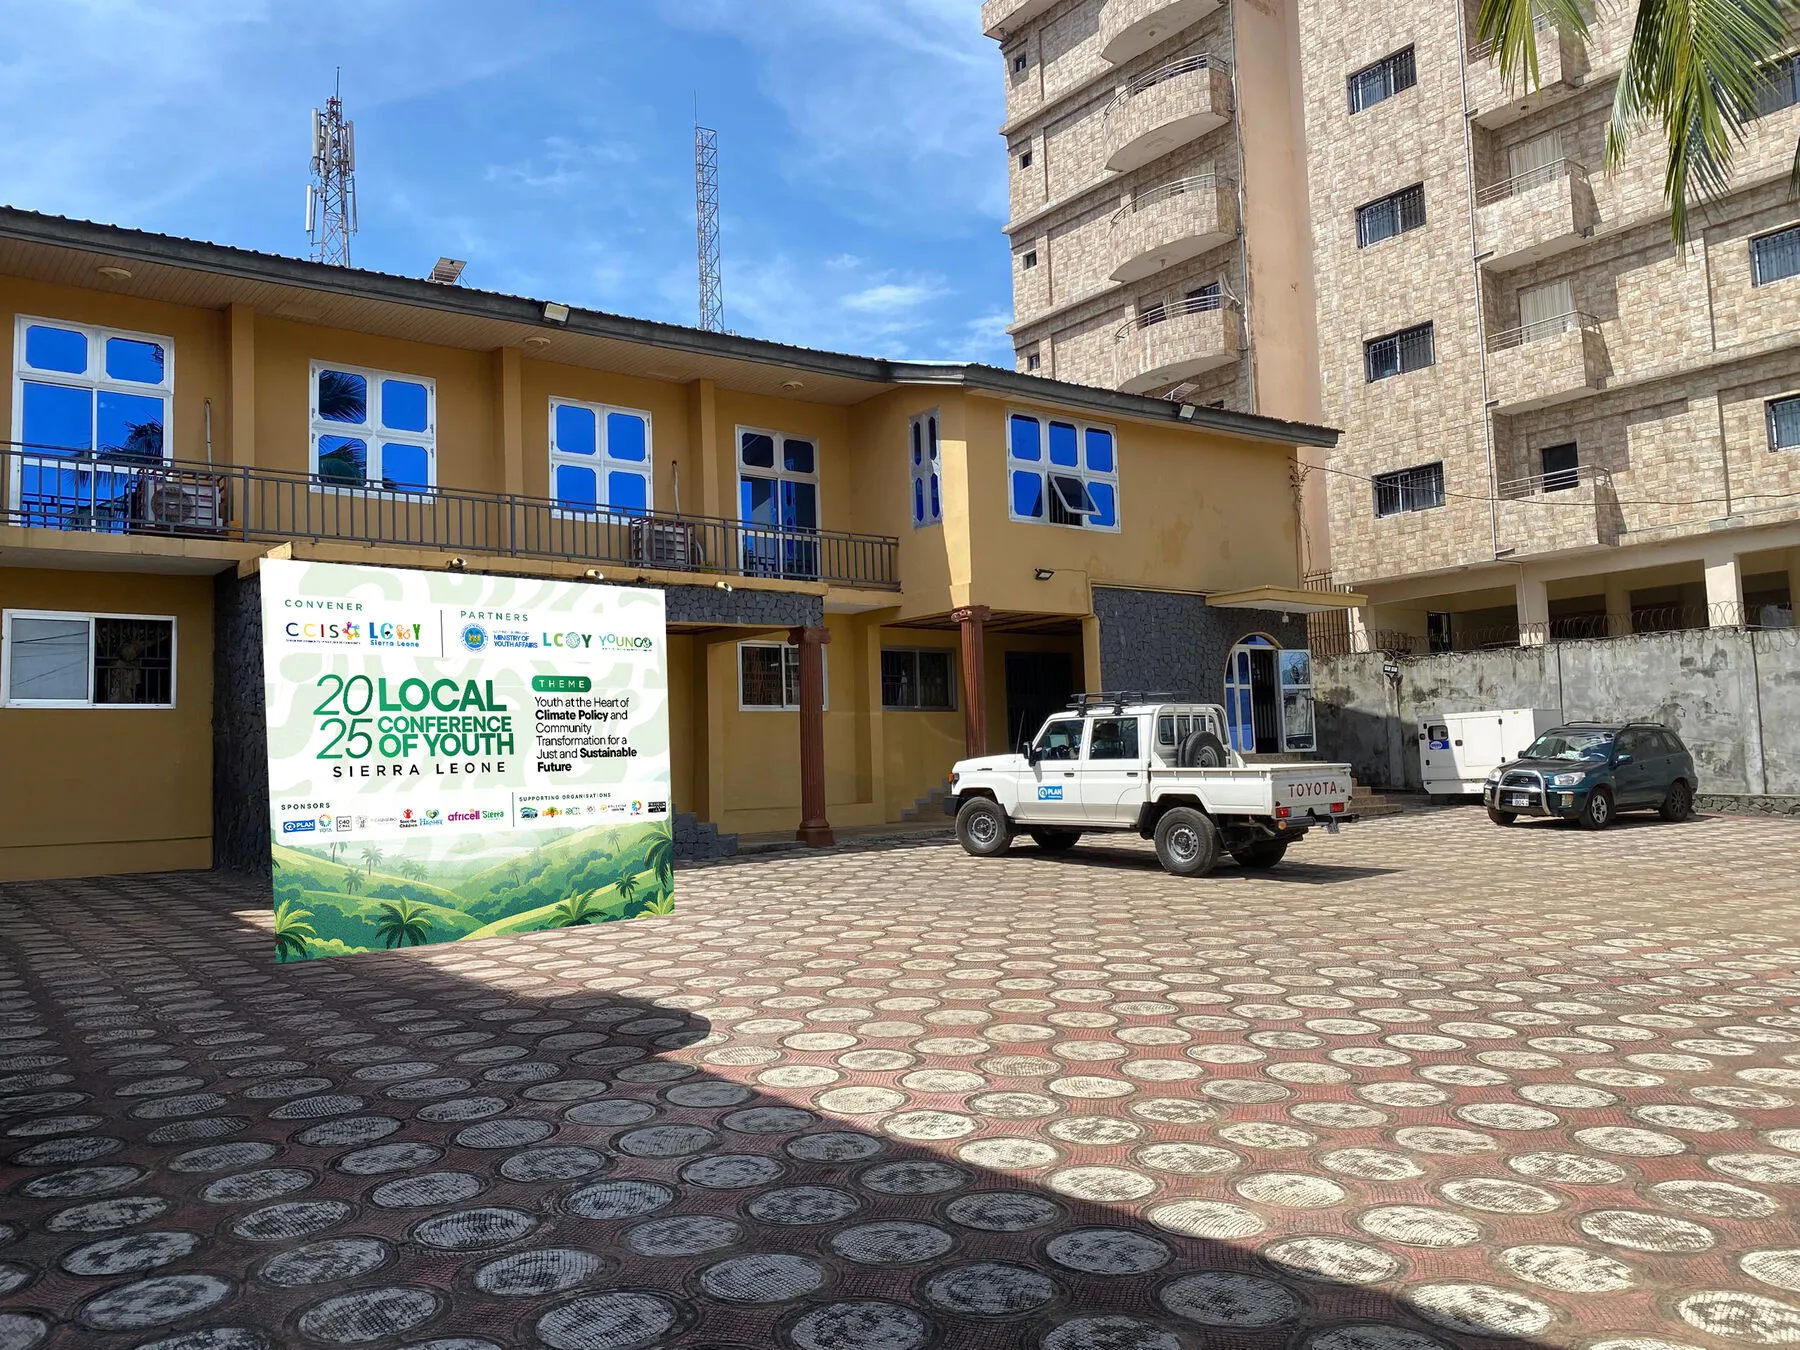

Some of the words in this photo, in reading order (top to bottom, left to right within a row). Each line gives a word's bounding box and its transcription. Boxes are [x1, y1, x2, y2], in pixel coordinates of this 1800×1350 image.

[284, 599, 363, 611] CONVENER
[460, 610, 529, 622] PARTNERS
[515, 641, 538, 649] AFFAIRS
[539, 679, 585, 689] THEME
[313, 674, 374, 716] 20
[378, 677, 507, 712] LOCAL
[534, 696, 563, 708] Youth
[565, 698, 575, 708] at
[576, 697, 592, 708] the
[593, 697, 619, 708] Heart
[620, 697, 630, 708] of
[535, 709, 576, 720] Climate
[578, 709, 609, 722] Policy
[610, 710, 628, 720] and
[377, 715, 512, 734] CONFERENCE
[535, 722, 592, 735] Community
[316, 717, 373, 760] 25
[536, 735, 606, 746] Transformation
[607, 734, 620, 745] for
[621, 736, 628, 745] a
[378, 733, 419, 758] OF
[422, 732, 515, 757] YOUTH
[536, 748, 558, 760] Just
[559, 748, 578, 759] and
[579, 747, 638, 758] Sustainable
[333, 763, 420, 778] SIERRA
[436, 761, 506, 775] LEONE
[537, 761, 572, 773] Future
[1047, 788, 1062, 796] PLAN
[1288, 781, 1337, 798] TOYOTA
[518, 794, 560, 802] SUPPORTING
[562, 792, 612, 800] ORGANISATIONS
[281, 802, 331, 811] SPONSORS
[447, 809, 480, 822] africell
[482, 810, 505, 819] Sierra
[296, 821, 314, 829] PLAN
